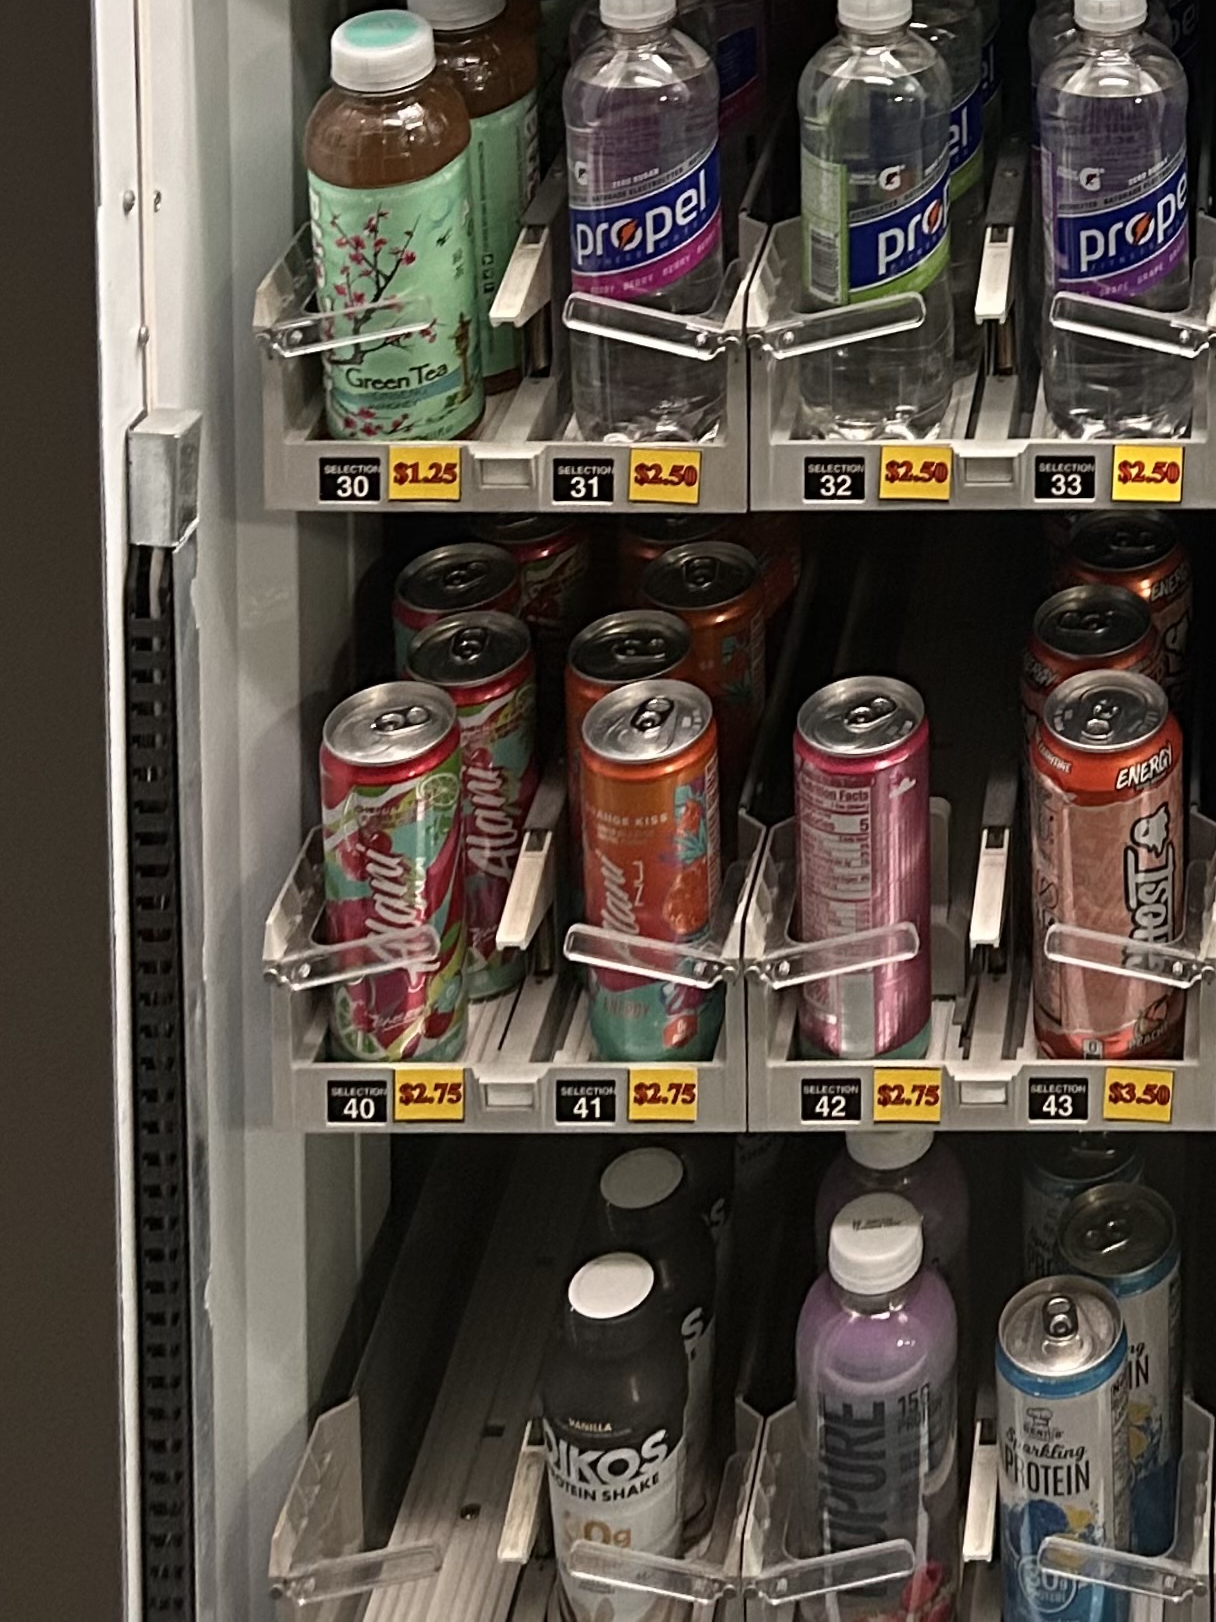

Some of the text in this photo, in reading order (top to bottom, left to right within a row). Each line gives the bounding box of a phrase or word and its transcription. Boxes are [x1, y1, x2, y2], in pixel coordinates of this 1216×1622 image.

[576, 168, 707, 266] propel
[344, 362, 449, 391] Green Tea
[323, 464, 380, 474] SELECTION
[393, 461, 458, 486] $1.25
[557, 465, 614, 475] SELECTION
[634, 462, 699, 488] $2.50
[807, 463, 865, 473] SELECTION
[885, 459, 949, 484] $2.50
[1038, 462, 1095, 472] SELECTION
[1117, 460, 1180, 485] $2.50
[336, 475, 369, 498] 30
[570, 476, 598, 498] 31
[820, 474, 852, 497] 32
[1051, 473, 1082, 496] 33
[1115, 743, 1173, 791] ENERGY
[839, 789, 869, 800] Facts
[635, 812, 669, 826] KISS
[859, 817, 869, 832] 5
[399, 1082, 462, 1106] $2.75
[633, 1082, 696, 1106] $2.75
[803, 1084, 859, 1094] SELECTION
[877, 1083, 940, 1107] $2.75
[1030, 1083, 1087, 1093] SELECTION
[1108, 1082, 1171, 1106] $3.50
[343, 1097, 375, 1119] 40
[573, 1097, 601, 1119] 41
[815, 1095, 846, 1117] 42
[1042, 1094, 1073, 1117] 43
[568, 1417, 613, 1433] VANILLA
[1004, 1446, 1090, 1498] PROTEIN
[602, 1471, 660, 1503] SHAKE
